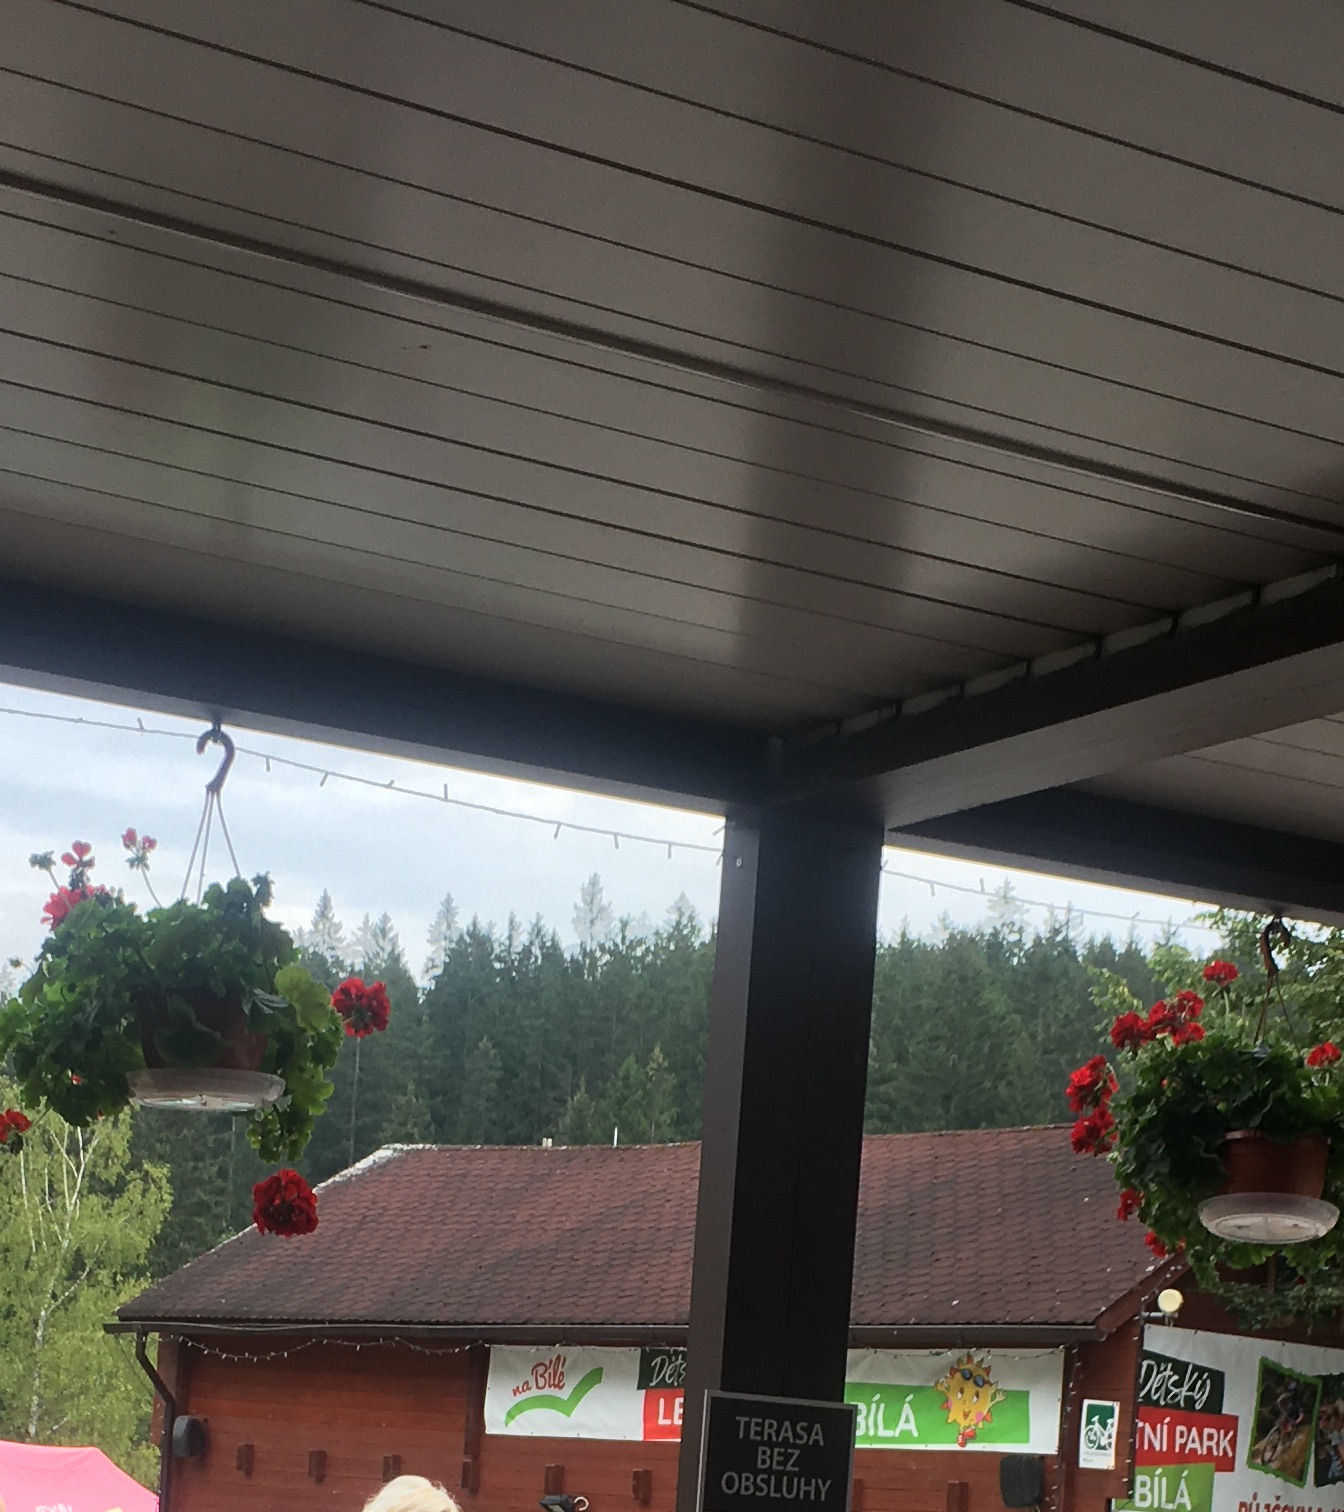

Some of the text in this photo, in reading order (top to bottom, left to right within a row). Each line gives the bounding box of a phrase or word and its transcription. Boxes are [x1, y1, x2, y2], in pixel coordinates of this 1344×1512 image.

[512, 1354, 567, 1397] na Bílé
[1138, 1359, 1211, 1410] Dětský
[657, 1397, 684, 1425] LE
[850, 1393, 919, 1437] BÍLÁ
[735, 1416, 825, 1446] TERASA
[1174, 1424, 1235, 1458] PARK
[757, 1446, 800, 1472] BEZ
[721, 1471, 832, 1501] OBSLUHY
[1134, 1467, 1192, 1511] BÍLÁ
